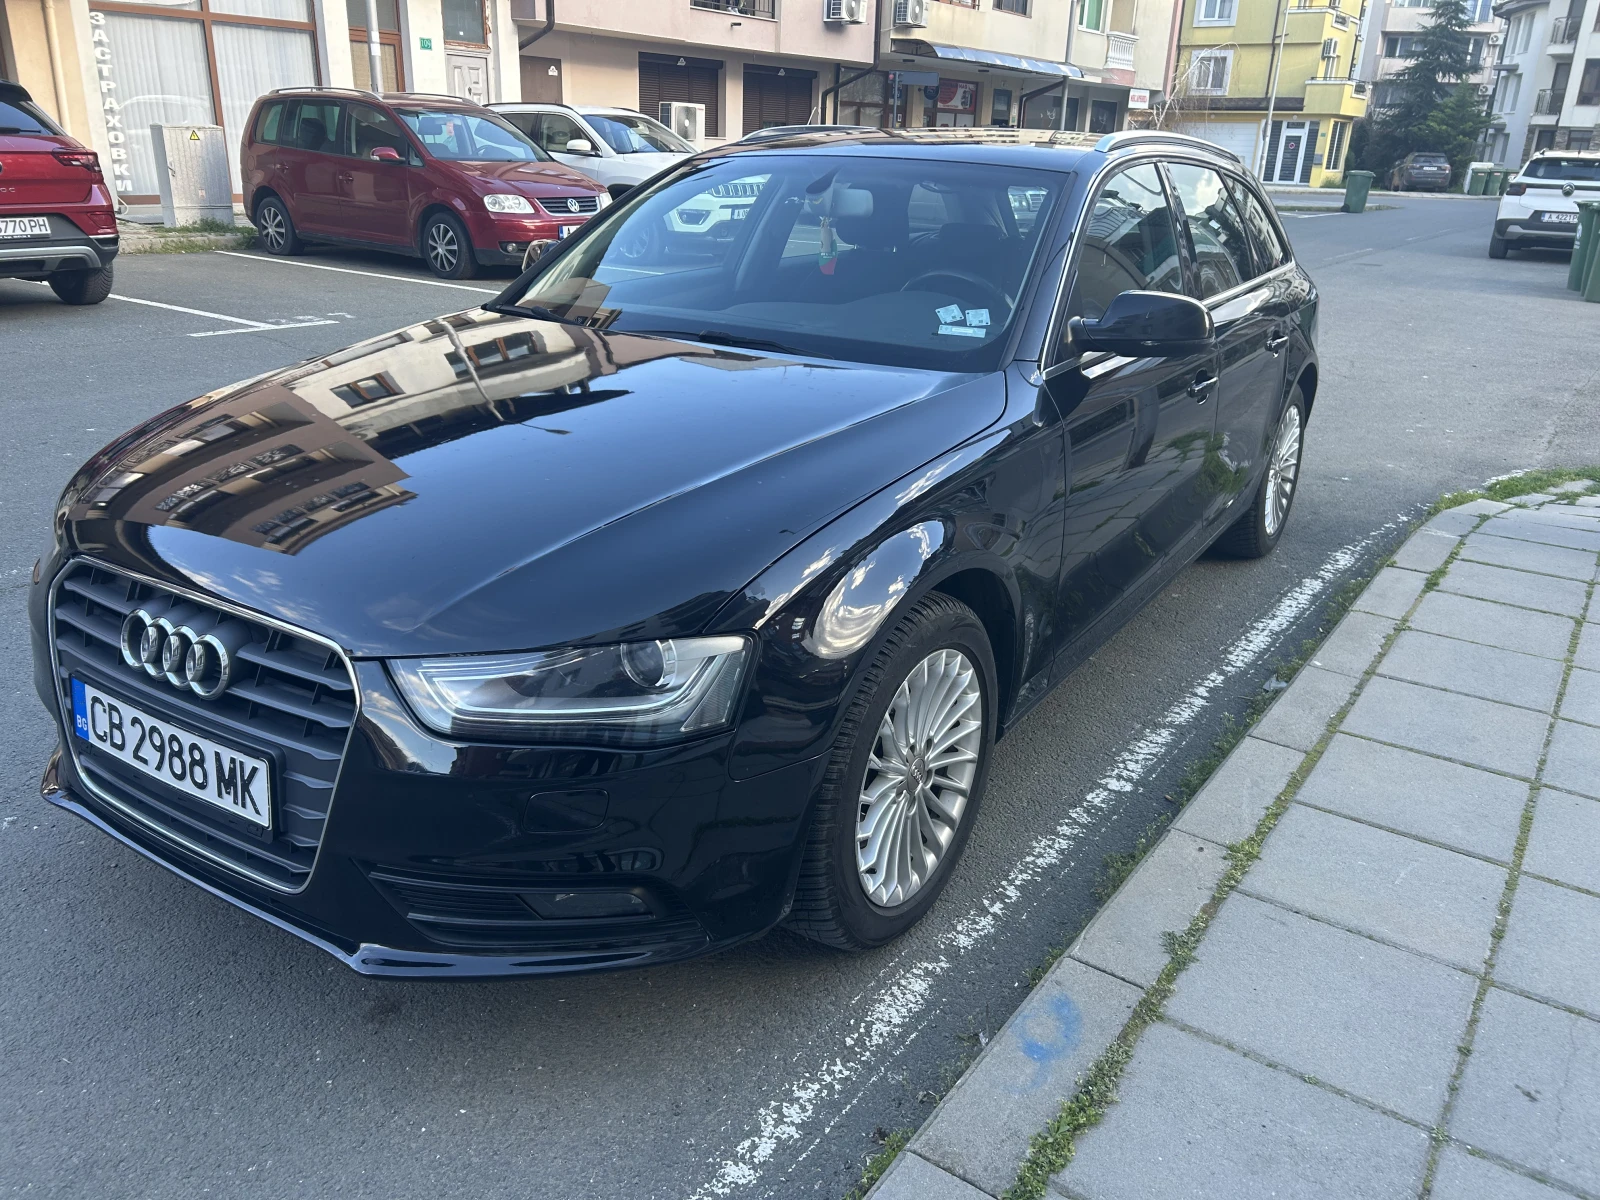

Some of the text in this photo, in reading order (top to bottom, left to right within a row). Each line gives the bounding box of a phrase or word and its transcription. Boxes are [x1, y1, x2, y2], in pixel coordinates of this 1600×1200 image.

[421, 39, 431, 49] 109
[89, 11, 133, 192] ЗАСТРАХОВКИ
[0, 219, 27, 233] 770
[76, 714, 88, 731] BG
